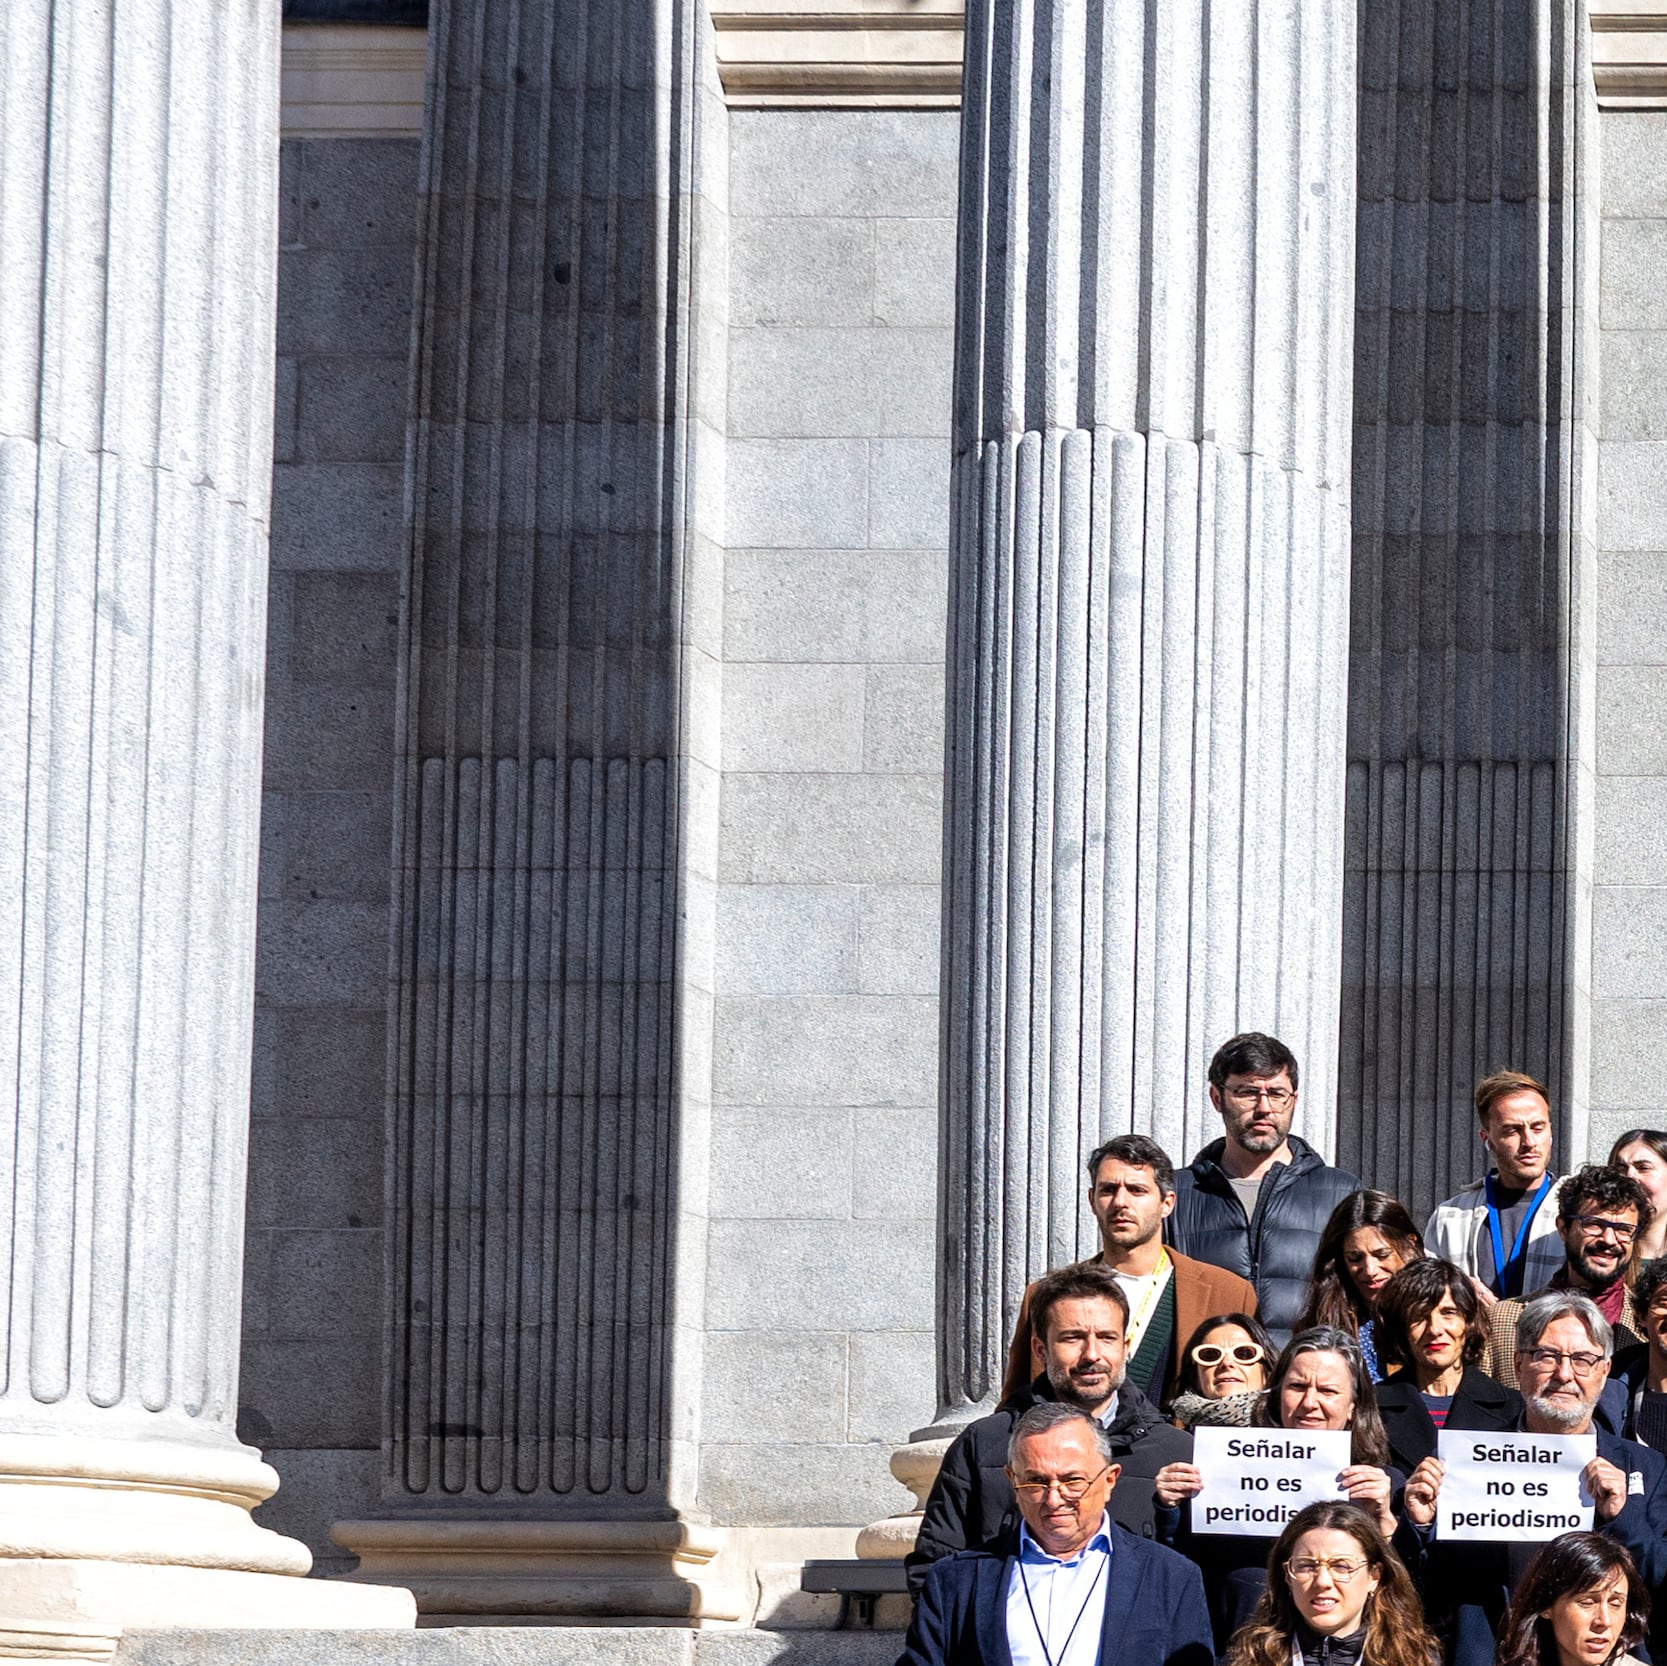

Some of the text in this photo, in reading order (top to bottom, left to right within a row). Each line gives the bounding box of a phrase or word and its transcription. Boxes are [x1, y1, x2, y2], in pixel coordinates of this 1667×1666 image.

[1227, 1439, 1317, 1460] Señalar
[1472, 1443, 1563, 1464] Señalar
[1240, 1476, 1302, 1493] no es
[1486, 1481, 1549, 1497] no es
[1206, 1504, 1300, 1525] periodis
[1451, 1508, 1581, 1531] periodismo
